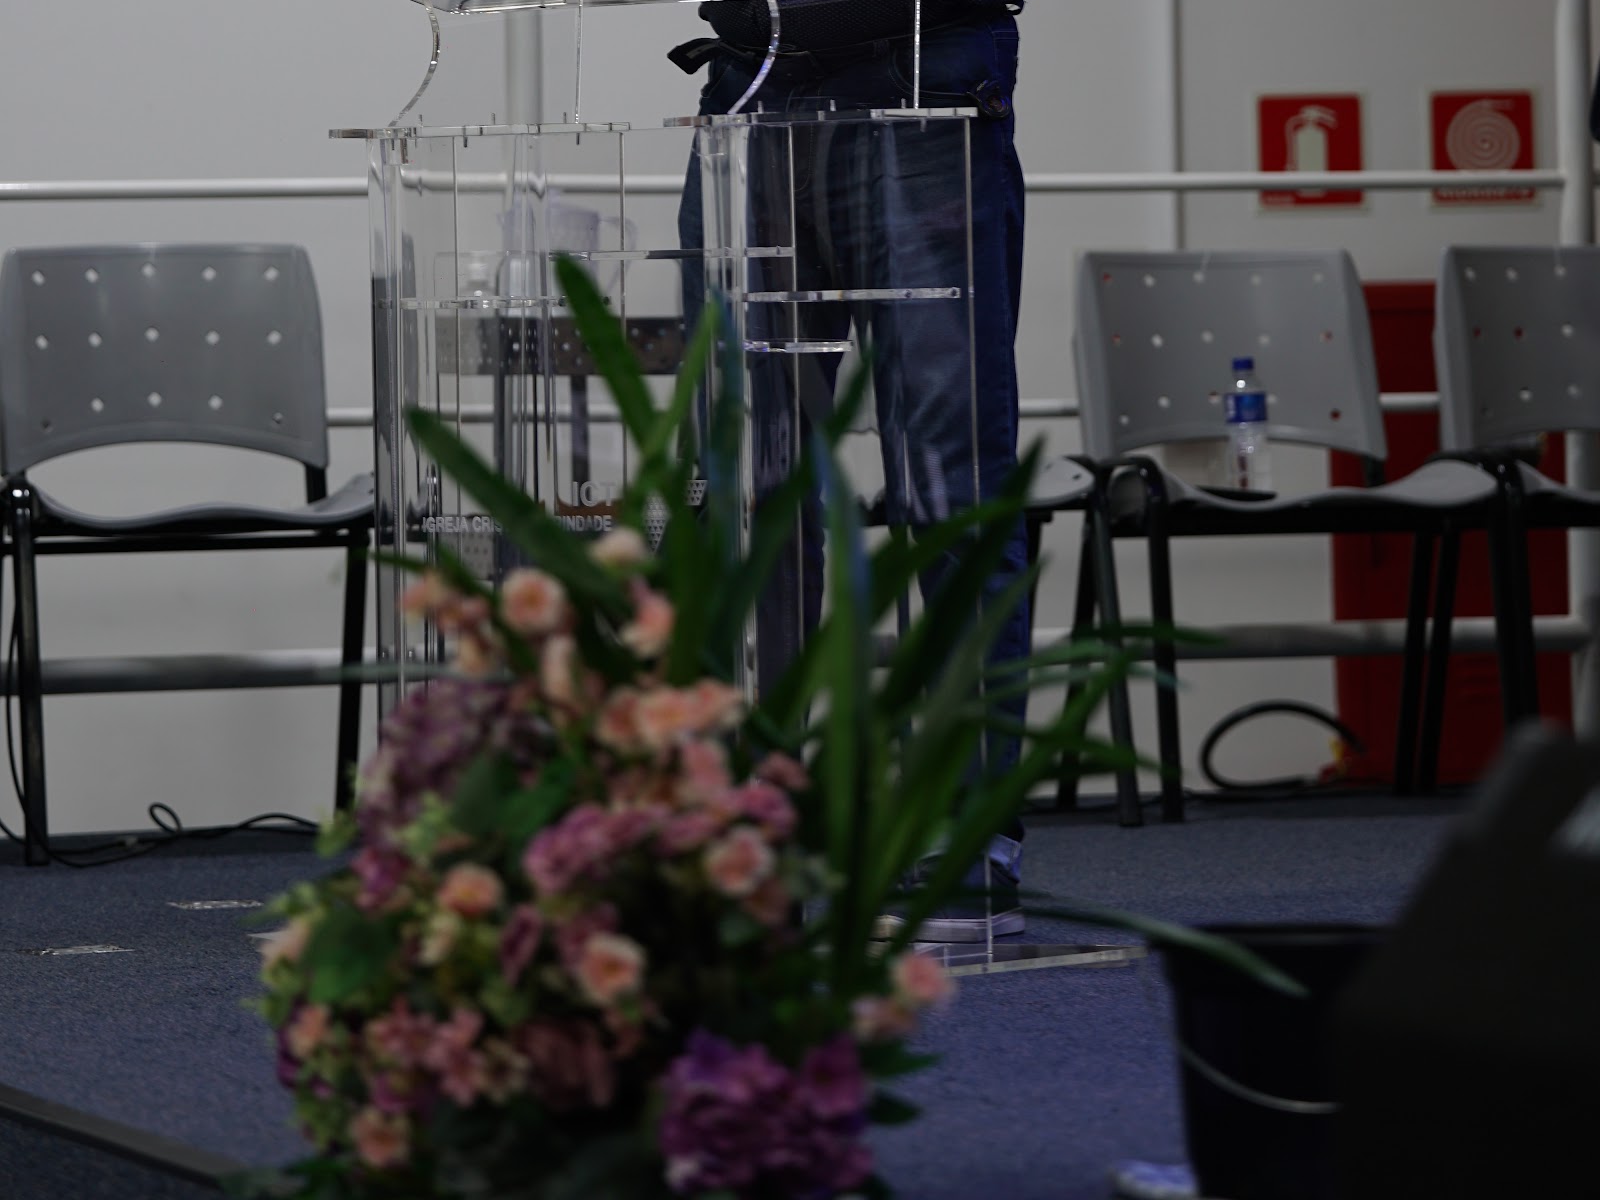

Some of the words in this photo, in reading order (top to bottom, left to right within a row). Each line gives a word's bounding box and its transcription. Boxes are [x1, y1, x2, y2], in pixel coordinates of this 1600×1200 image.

[572, 481, 617, 507] ICT
[422, 516, 469, 533] IGREJA
[472, 516, 504, 534] CRIS
[553, 515, 612, 532] INDADE
